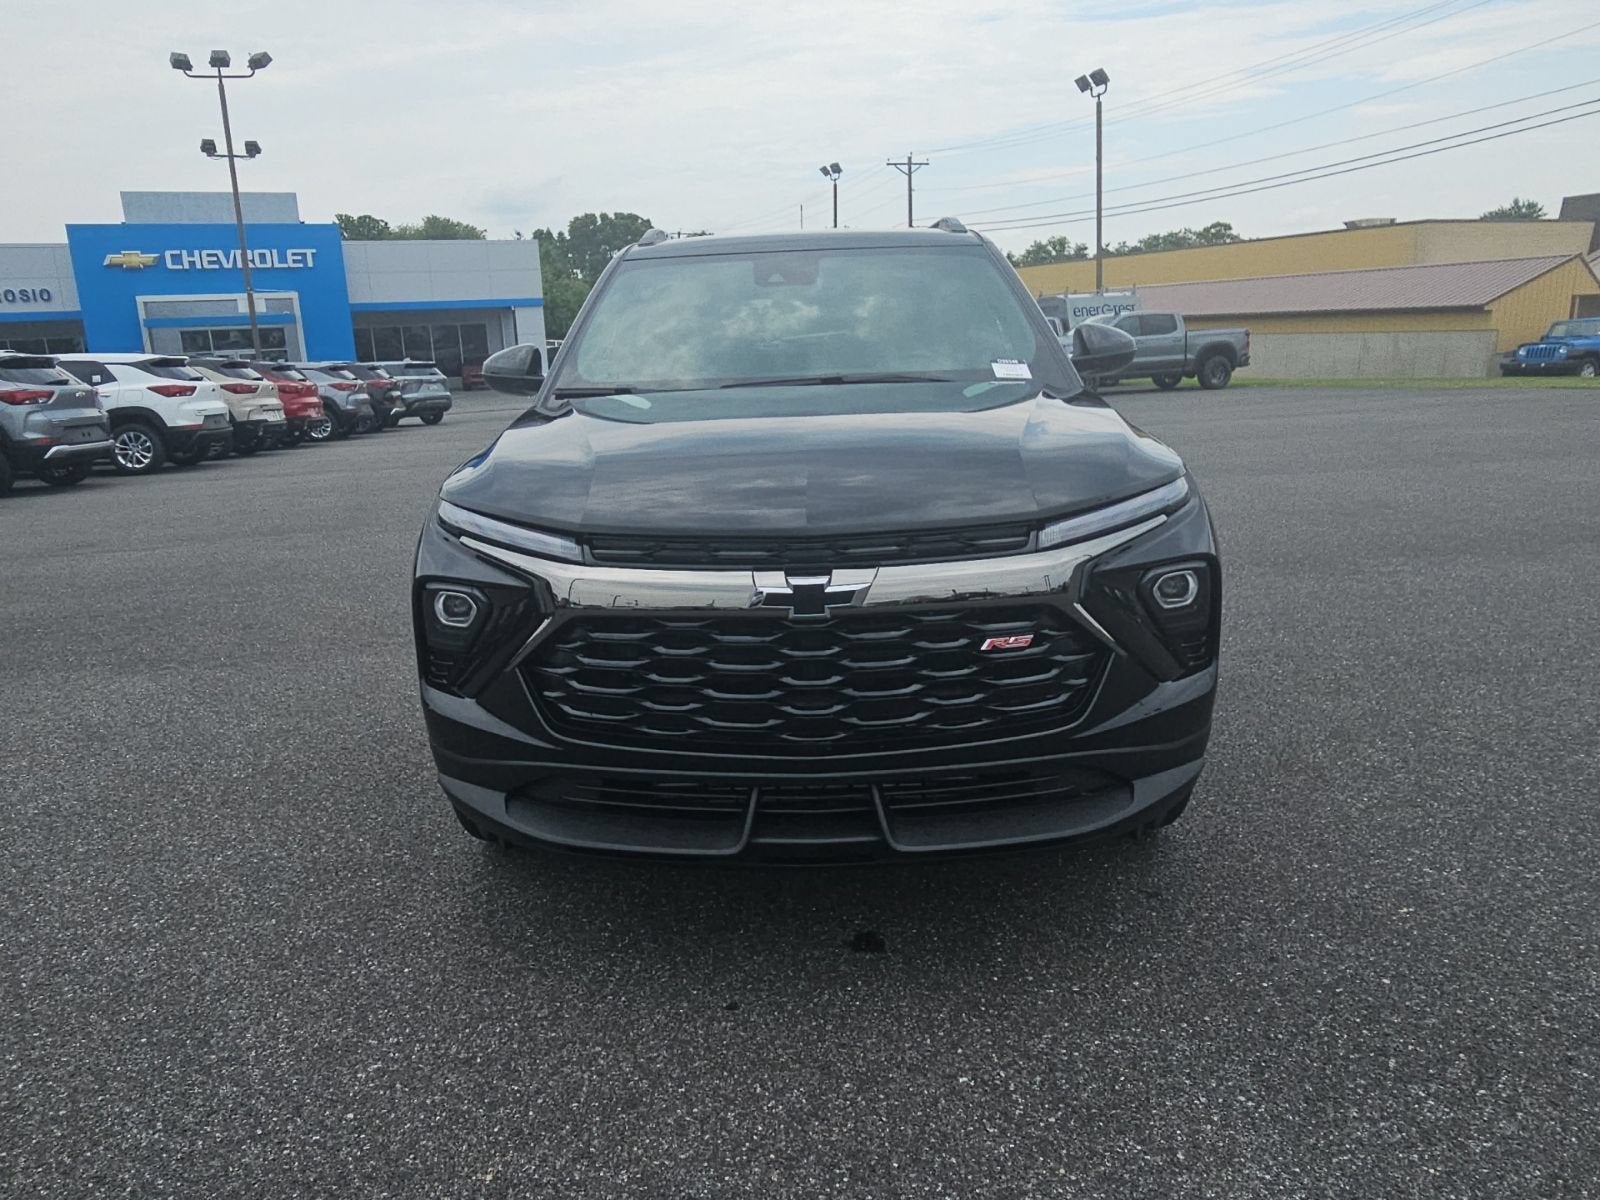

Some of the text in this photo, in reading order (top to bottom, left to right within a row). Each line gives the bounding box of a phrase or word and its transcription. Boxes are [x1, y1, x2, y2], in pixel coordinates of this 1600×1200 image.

[164, 249, 317, 270] CHEVROLET
[0, 288, 52, 303] OSIO
[980, 634, 1034, 651] RS
